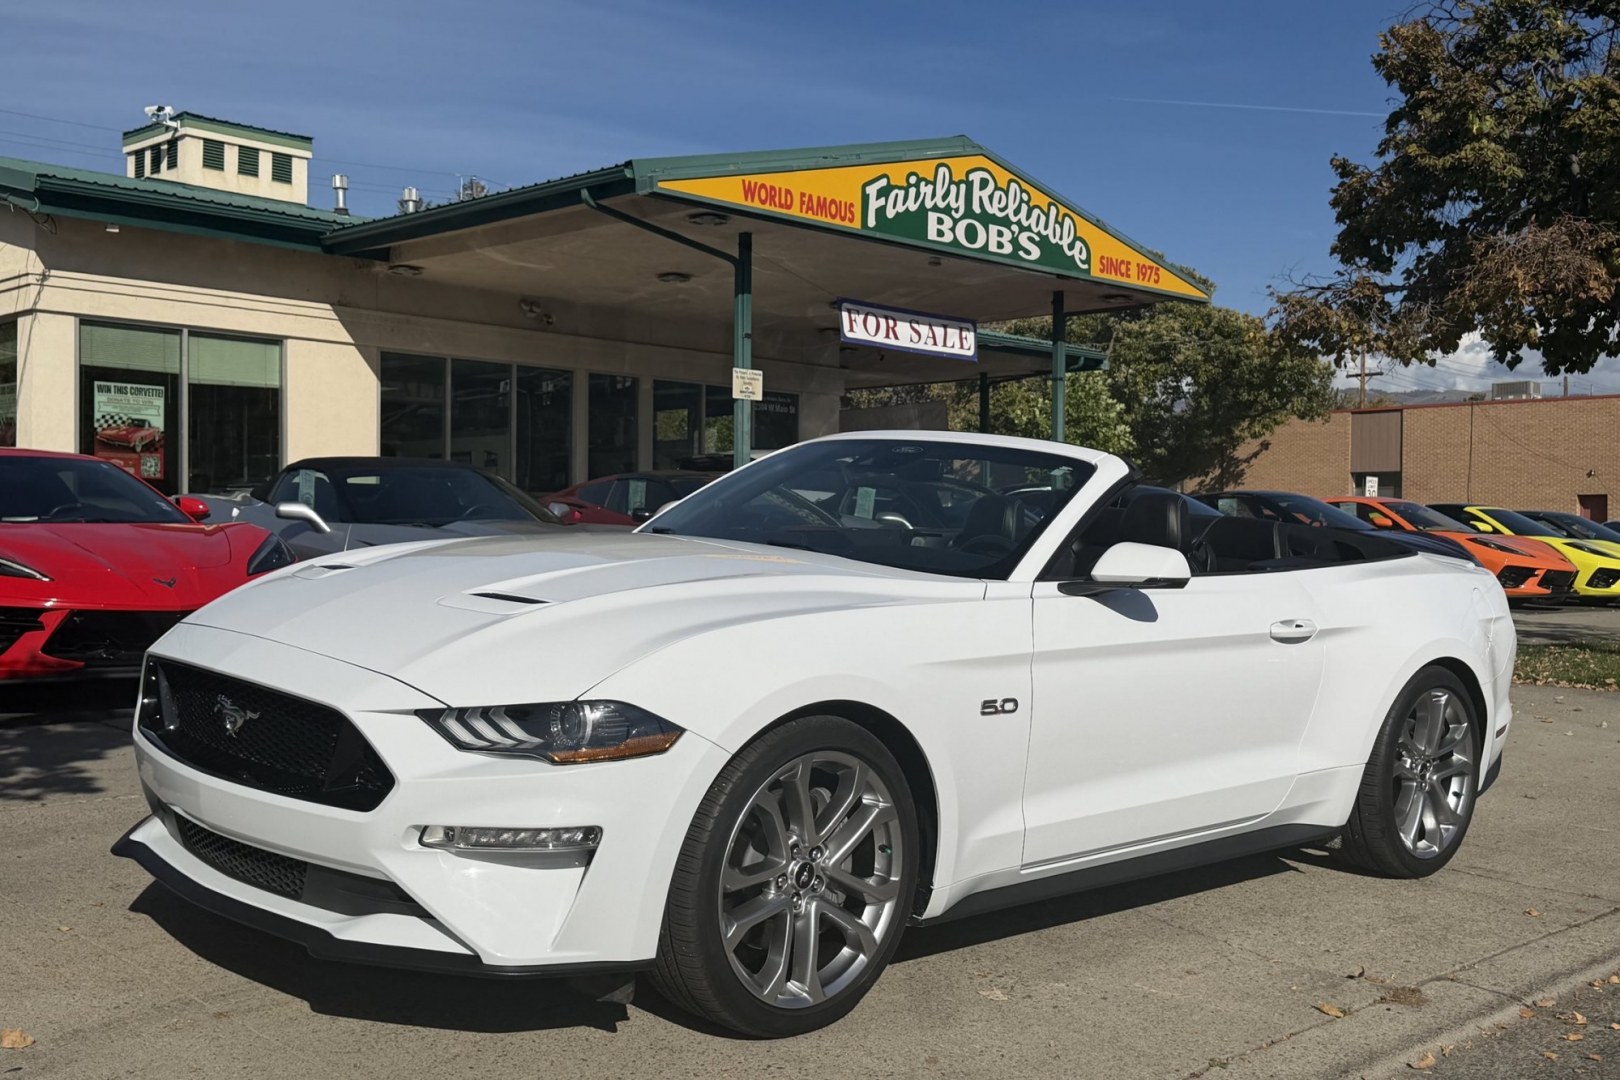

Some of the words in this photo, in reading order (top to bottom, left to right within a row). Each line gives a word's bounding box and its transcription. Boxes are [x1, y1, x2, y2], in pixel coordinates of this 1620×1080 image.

[742, 179, 794, 211] WORLD
[800, 192, 855, 223] FAMOUS
[865, 166, 966, 228] Fairly
[969, 170, 1088, 269] Reliable
[927, 211, 1041, 261] BOB'S
[1099, 255, 1131, 278] SINCE
[1136, 262, 1160, 284] 1975
[846, 307, 900, 341] FOR
[909, 319, 972, 351] SALE
[96, 384, 112, 394] WIN
[113, 385, 129, 395] THIS
[129, 387, 164, 398] CORVETTE!
[980, 697, 1019, 716] 5.0
